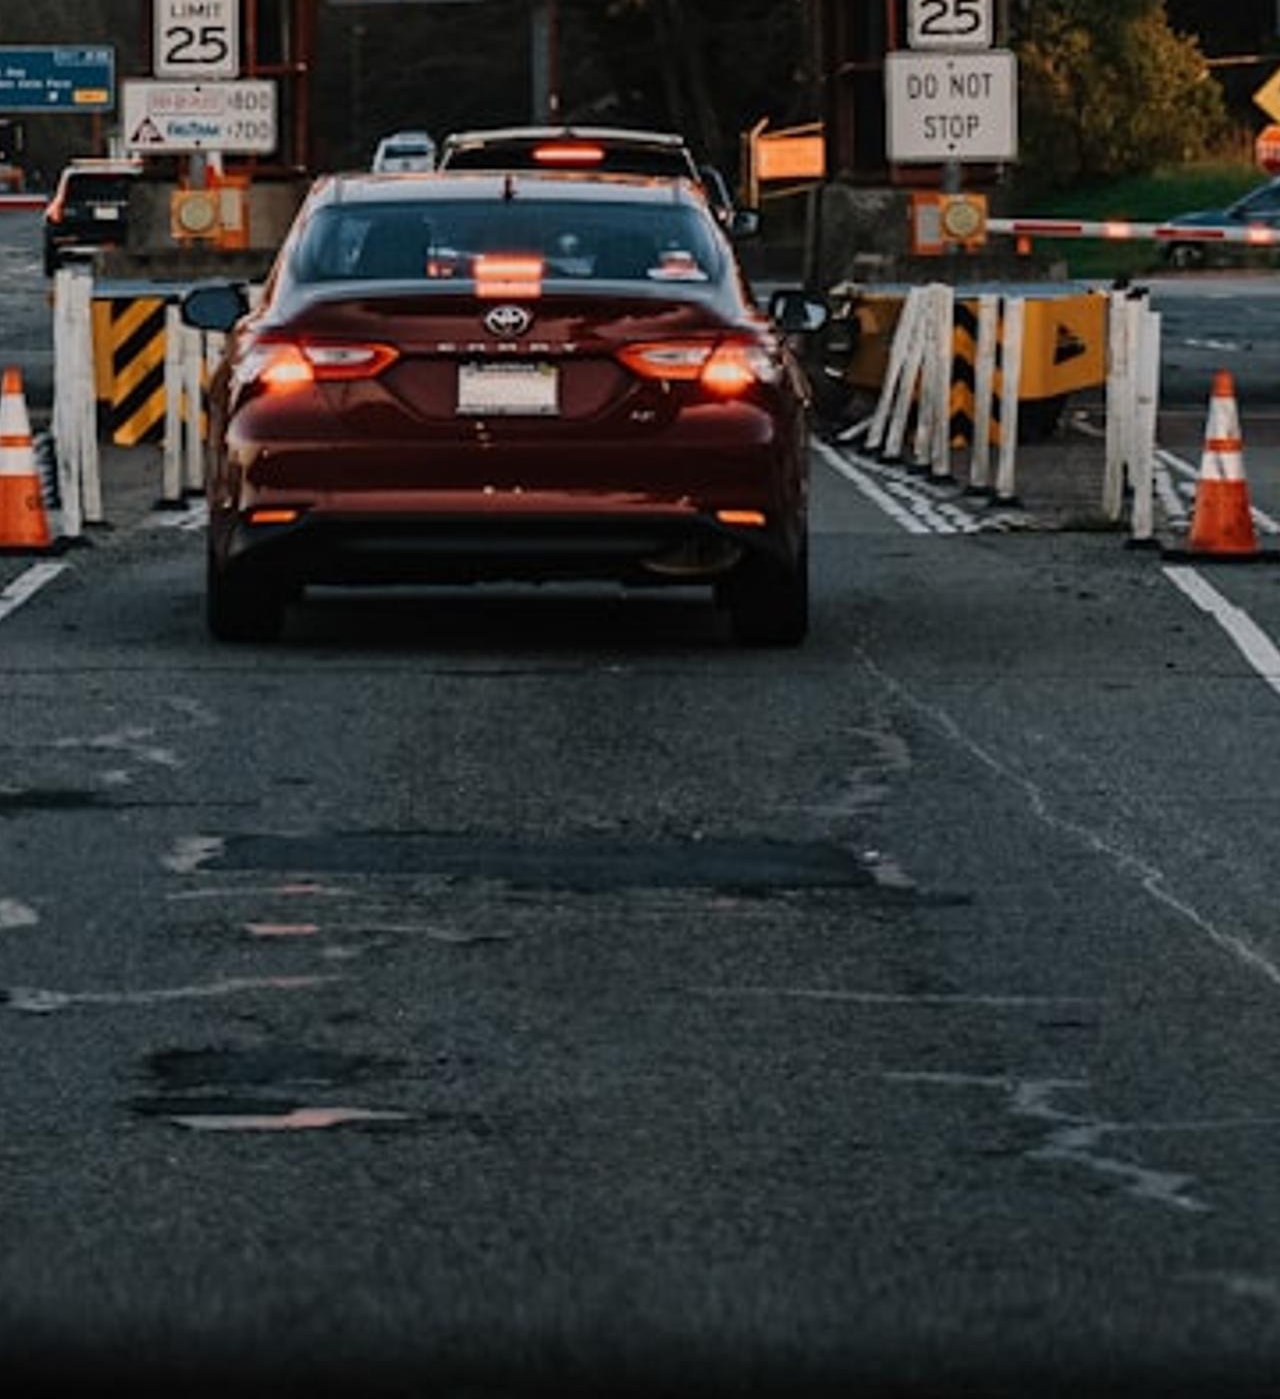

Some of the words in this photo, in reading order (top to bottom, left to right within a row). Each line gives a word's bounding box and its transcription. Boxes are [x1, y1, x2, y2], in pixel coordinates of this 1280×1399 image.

[171, 3, 223, 19] LIMIT
[165, 25, 230, 65] 25
[906, 73, 938, 99] DO
[950, 72, 993, 99] NOT
[923, 115, 980, 140] STOP
